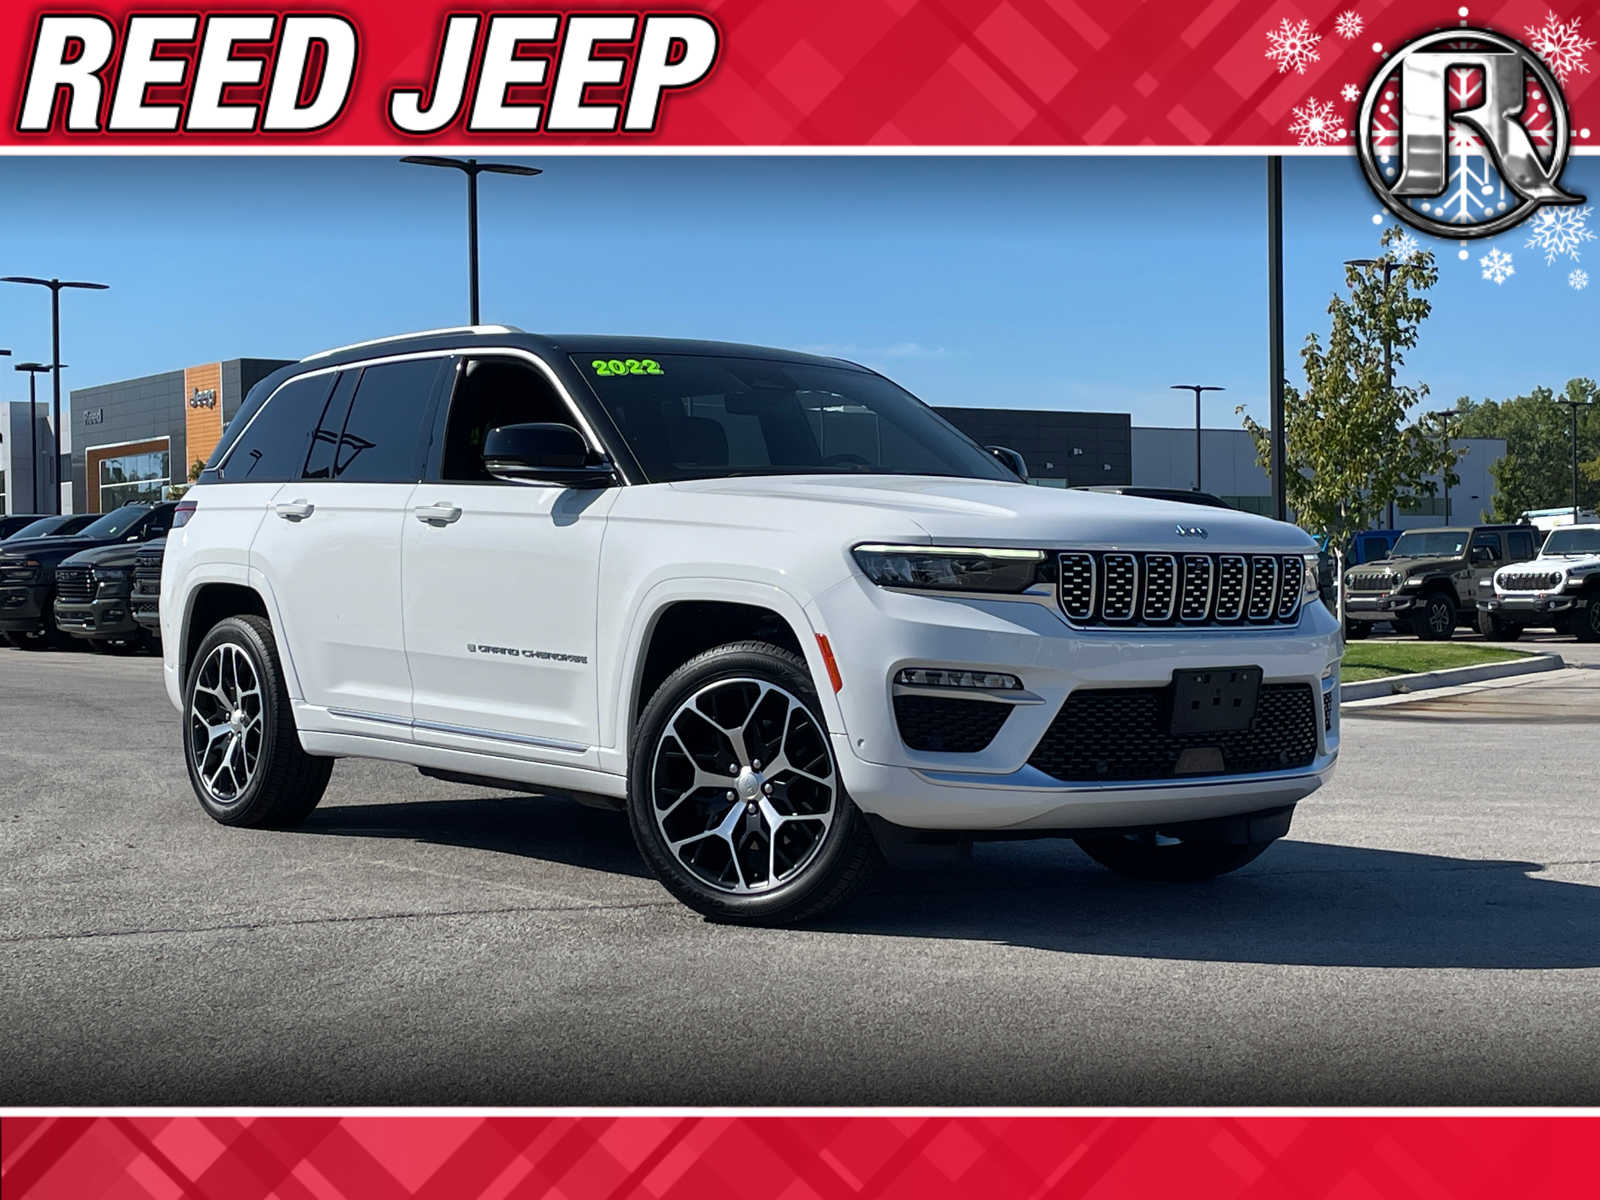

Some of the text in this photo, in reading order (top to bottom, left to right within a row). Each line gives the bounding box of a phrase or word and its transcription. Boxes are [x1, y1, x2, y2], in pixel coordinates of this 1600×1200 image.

[592, 358, 664, 377] 2022
[190, 387, 216, 410] Jeep
[478, 645, 588, 664] GRAND CHEROKEE
